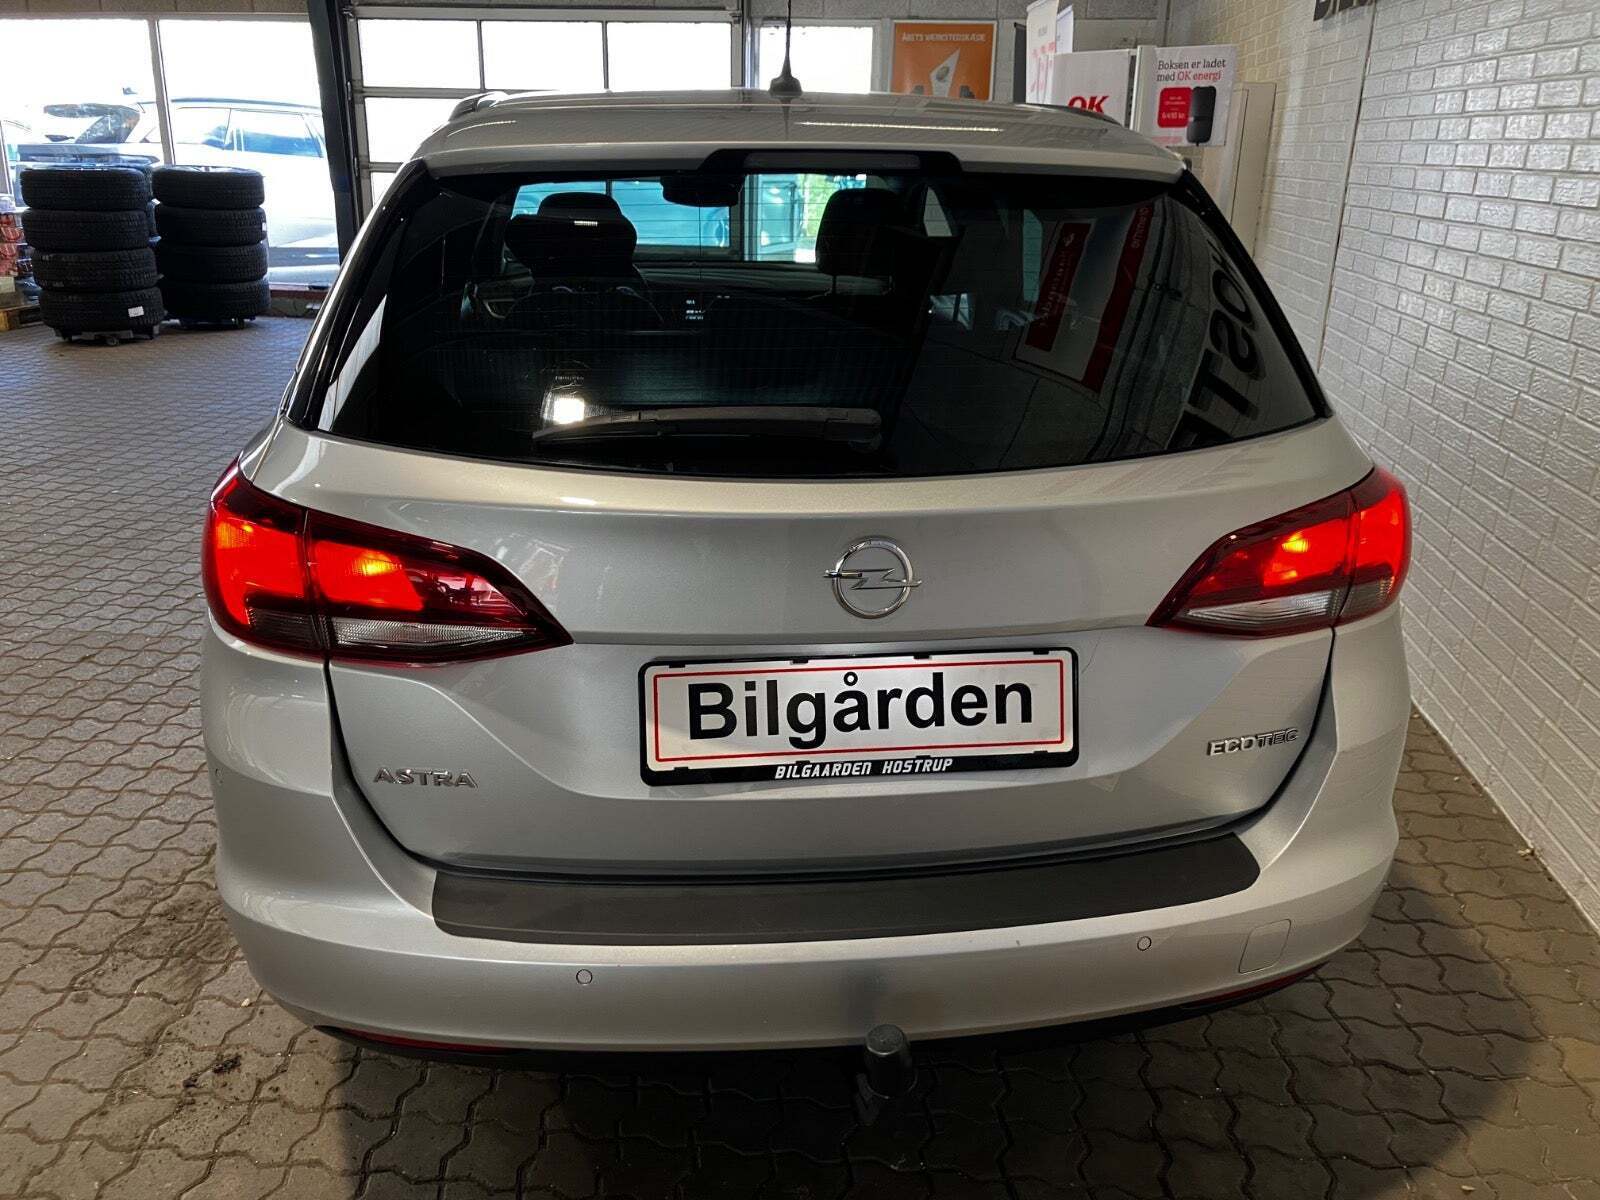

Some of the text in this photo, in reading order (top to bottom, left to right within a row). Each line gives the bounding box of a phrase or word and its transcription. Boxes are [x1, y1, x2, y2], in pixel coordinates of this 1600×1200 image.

[1158, 58, 1226, 70] Boksen er ladet
[1157, 70, 1221, 83] med OK energi
[688, 671, 1034, 749] Bilgården
[1206, 728, 1299, 756] ECOTEC
[373, 767, 478, 788] ASTRA
[775, 758, 953, 779] BILGAARDEN HOSTRUP
